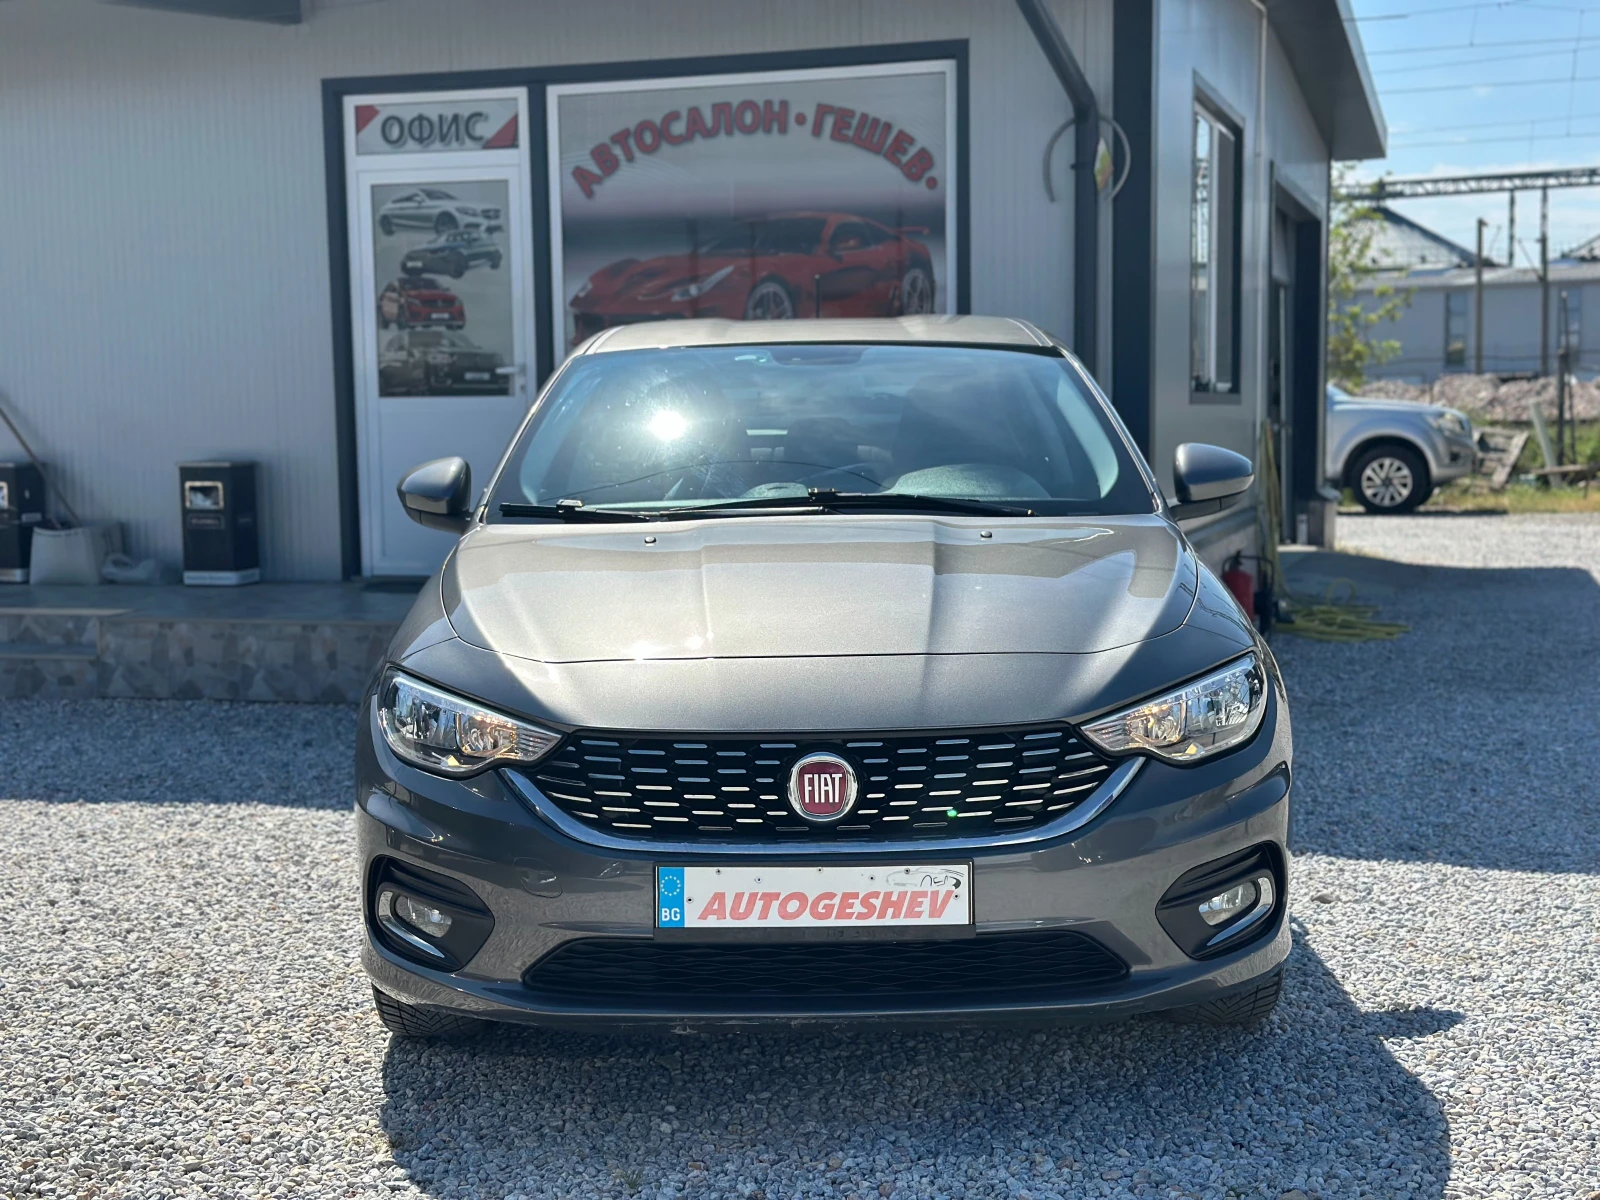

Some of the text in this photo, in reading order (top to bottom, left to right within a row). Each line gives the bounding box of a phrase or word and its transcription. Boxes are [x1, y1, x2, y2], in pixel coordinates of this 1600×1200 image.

[380, 111, 488, 146] ОФИС
[572, 100, 789, 199] АВТОСАЛОН
[804, 773, 843, 803] FIAT
[661, 907, 681, 921] BG
[697, 890, 954, 920] AUTOGESHEV
